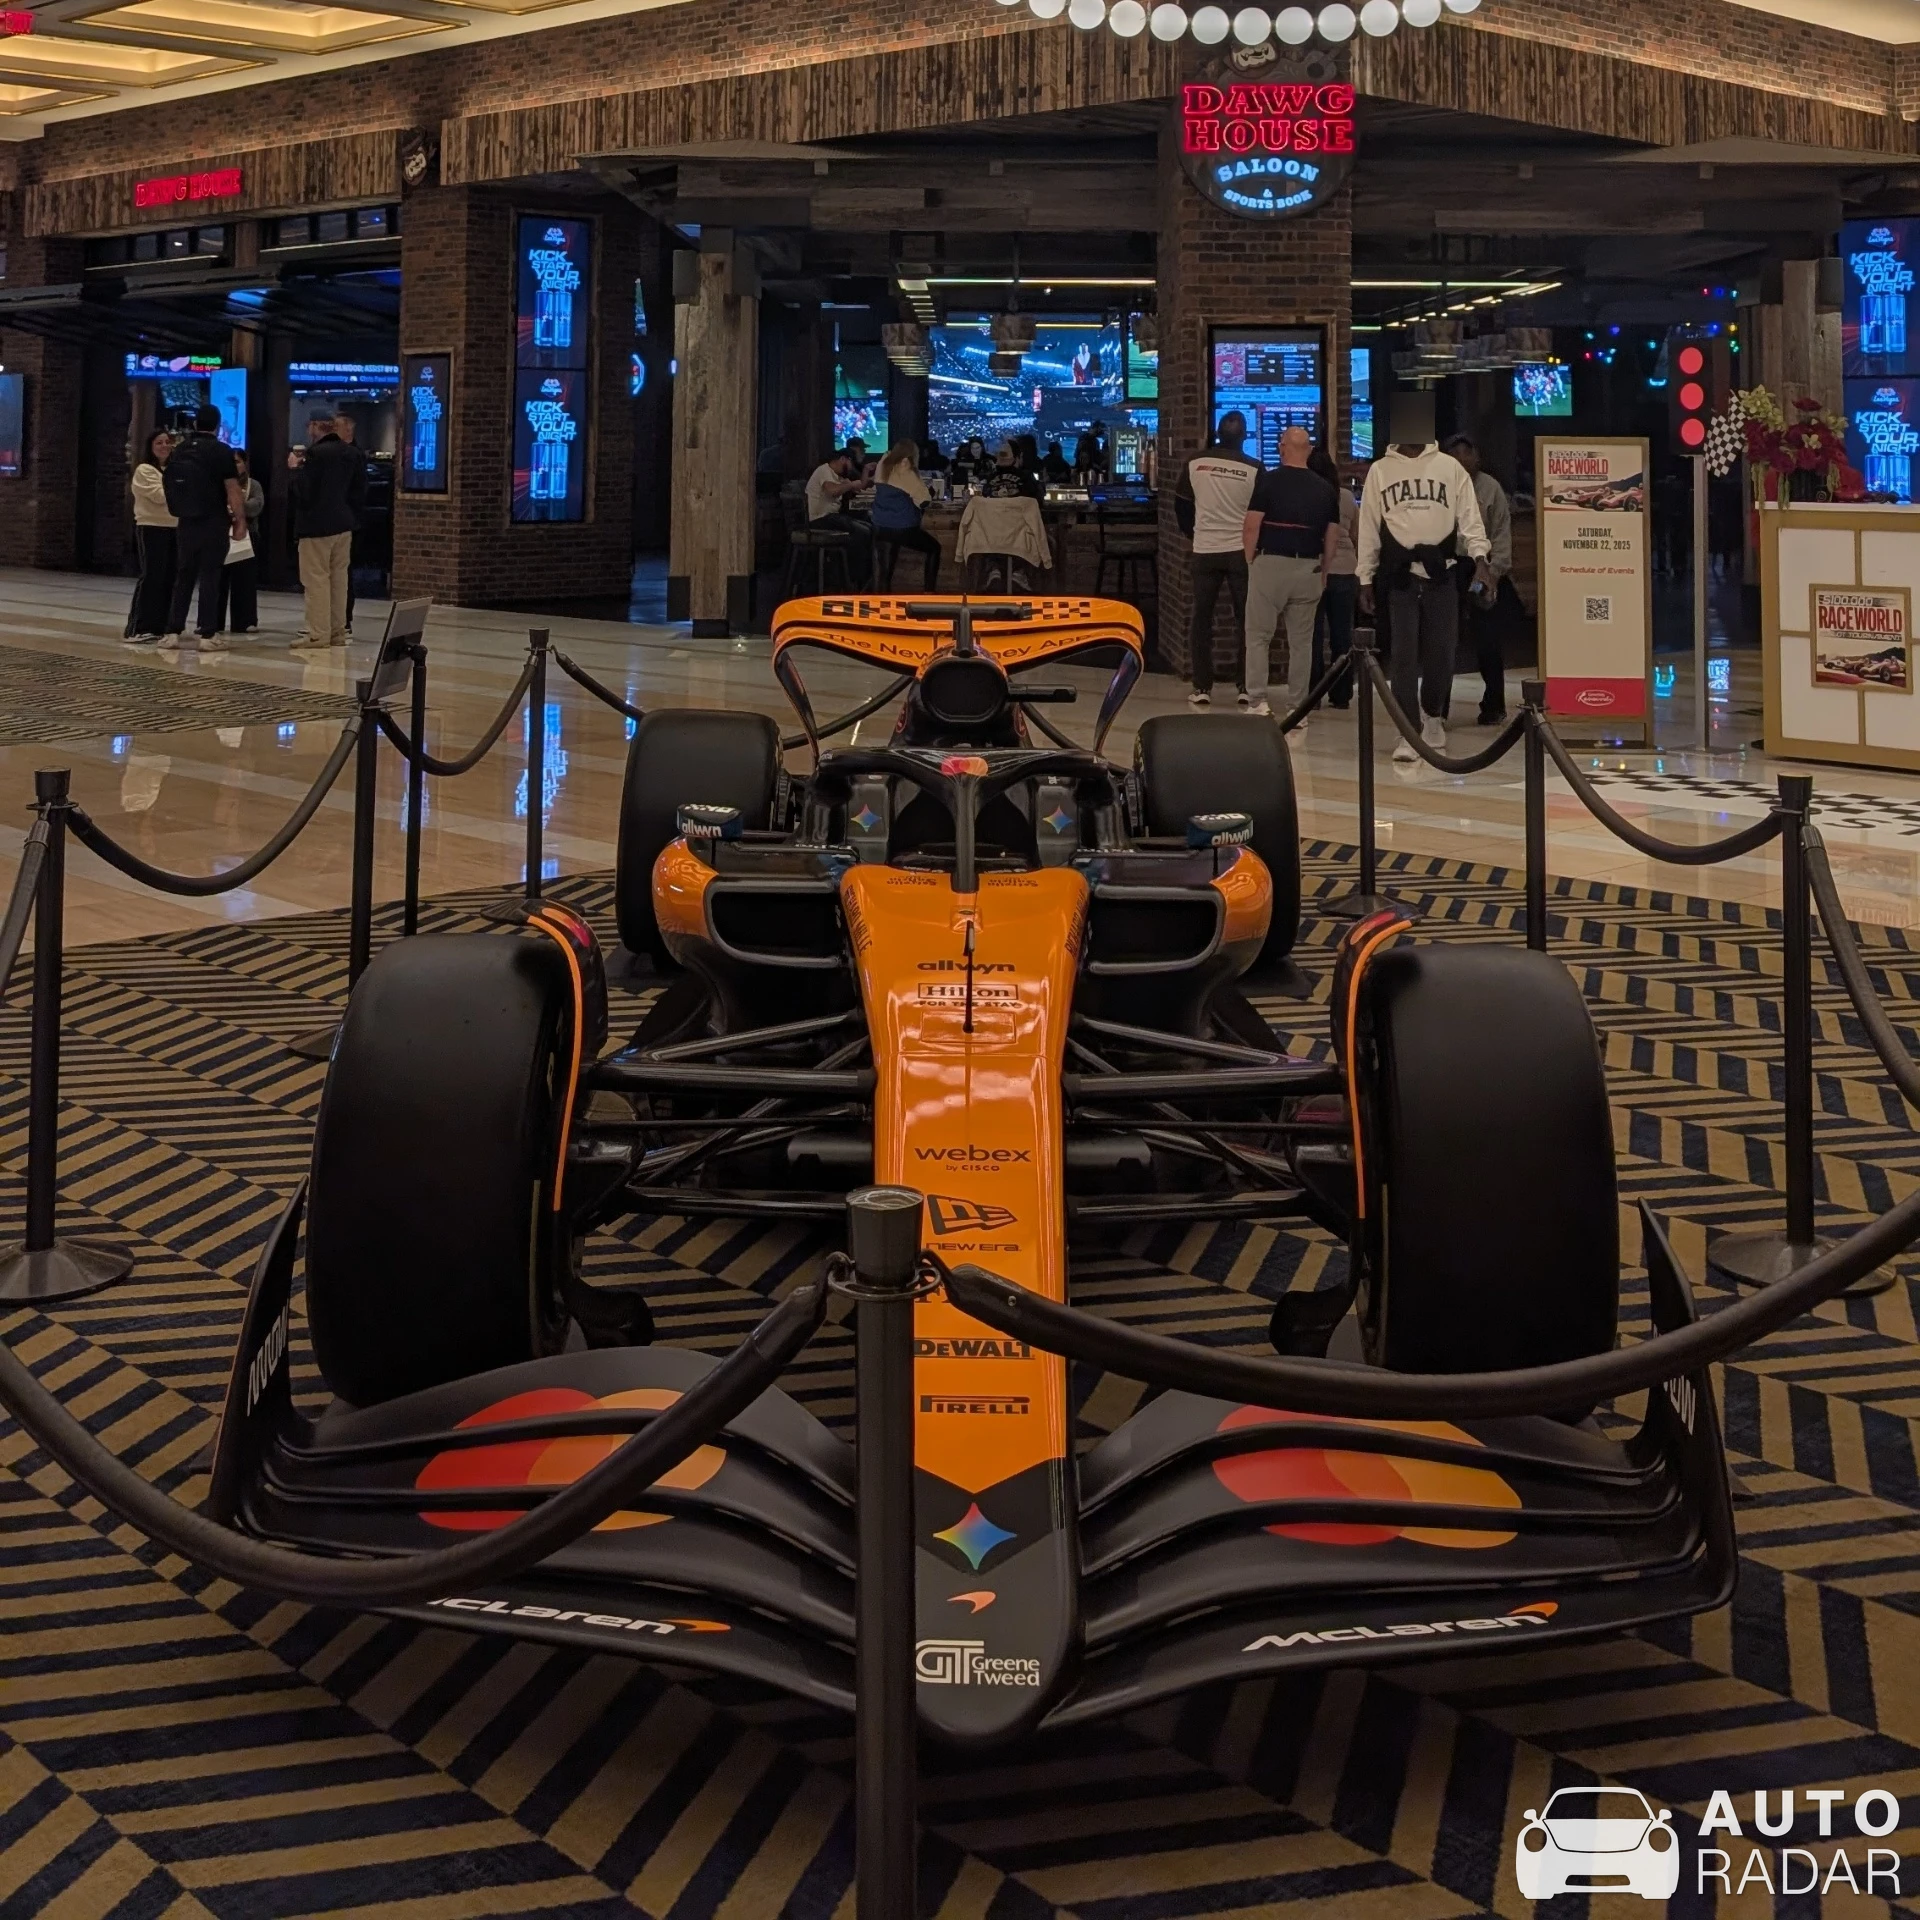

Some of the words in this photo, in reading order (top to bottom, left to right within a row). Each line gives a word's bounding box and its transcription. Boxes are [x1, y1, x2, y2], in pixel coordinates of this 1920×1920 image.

[1184, 84, 1354, 115] DAWG
[1185, 119, 1353, 151] HOUSE
[1217, 157, 1320, 182] SALOON
[1223, 189, 1274, 209] SPORTS
[1277, 189, 1313, 209] BOOK
[1262, 188, 1273, 198] &
[528, 249, 568, 262] KICK
[1850, 251, 1898, 265] KICK
[531, 260, 574, 270] START
[1854, 262, 1906, 273] START
[534, 269, 580, 281] YOUR
[1858, 270, 1914, 284] YOUR
[541, 279, 581, 290] NIGHT
[1867, 281, 1916, 292] NIGHT
[525, 401, 564, 413] KICK
[528, 412, 570, 421] START
[1855, 411, 1903, 424] KICK
[531, 421, 576, 432] YOUR
[1858, 423, 1911, 433] START
[537, 431, 577, 441] NIGHT
[1862, 432, 1919, 444] YOUR
[1871, 443, 1920, 453] NIGHT
[1211, 466, 1248, 477] AMG
[1548, 458, 1608, 475] RACEWORLD
[1380, 478, 1449, 513] ITALIA
[1577, 527, 1613, 538] SATURDAY,
[1563, 540, 1598, 549] NOVEMBER
[1600, 540, 1612, 551] 22,
[1613, 540, 1631, 550] 2025
[1559, 566, 1596, 574] Schedule
[1607, 567, 1635, 575] Events
[1818, 605, 1903, 632] RACEWORLD
[824, 632, 872, 649] The
[880, 642, 928, 660] New
[1040, 634, 1093, 650] App
[681, 819, 723, 838] allwyn
[1211, 828, 1250, 846] allwyn
[916, 959, 1016, 975] allwyn
[926, 986, 1010, 997] Hilon
[914, 1144, 1032, 1162] webex
[945, 1163, 958, 1172] by
[919, 1394, 1031, 1415] PIRELLI
[427, 1597, 677, 1635] cLaren
[1242, 1615, 1549, 1651] McLaren
[971, 1655, 1041, 1672] Greene
[972, 1669, 1041, 1686] Tweed
